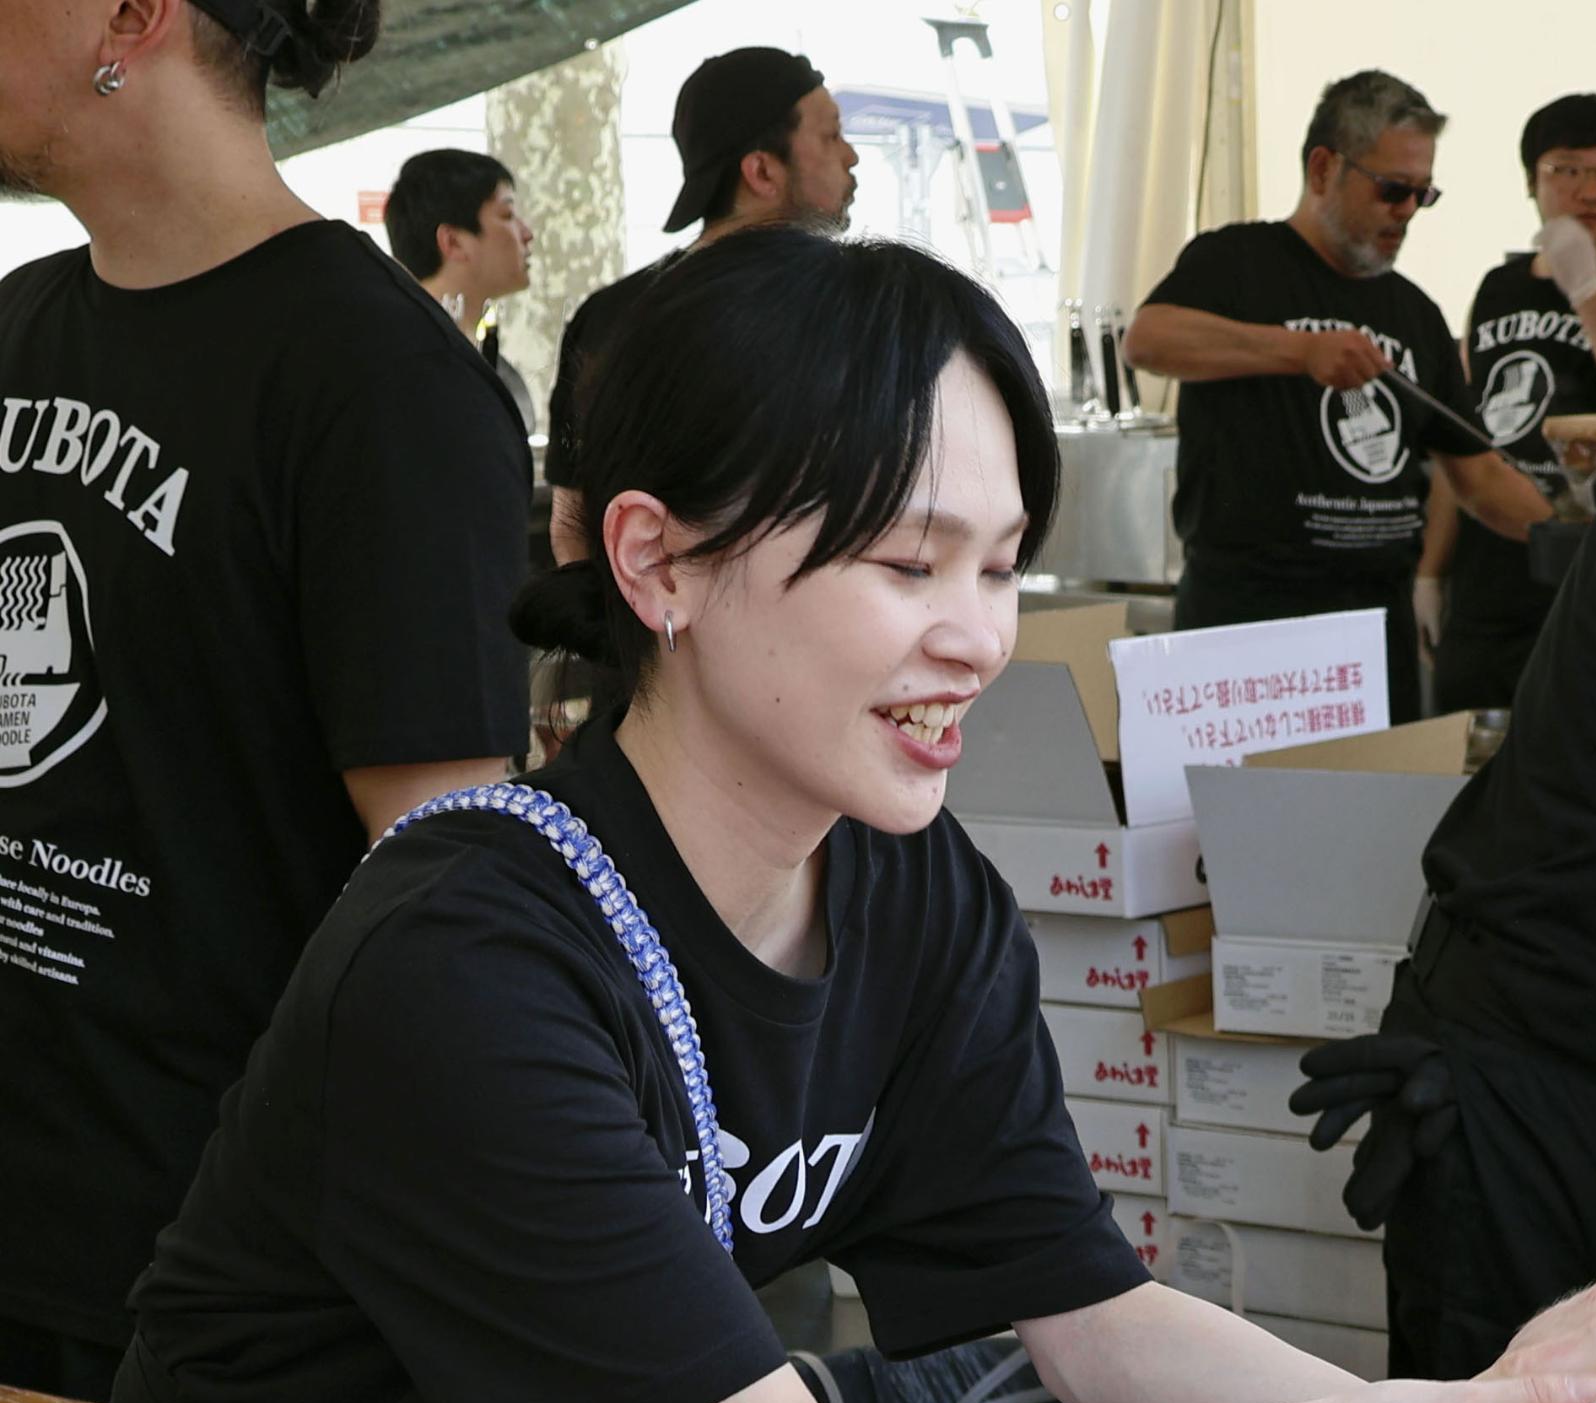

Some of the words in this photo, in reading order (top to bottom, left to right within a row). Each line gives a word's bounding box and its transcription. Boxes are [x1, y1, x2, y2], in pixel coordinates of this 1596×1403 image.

[0, 693, 36, 709] BOTA
[0, 729, 31, 746] ODLE
[28, 839, 151, 897] Noodles
